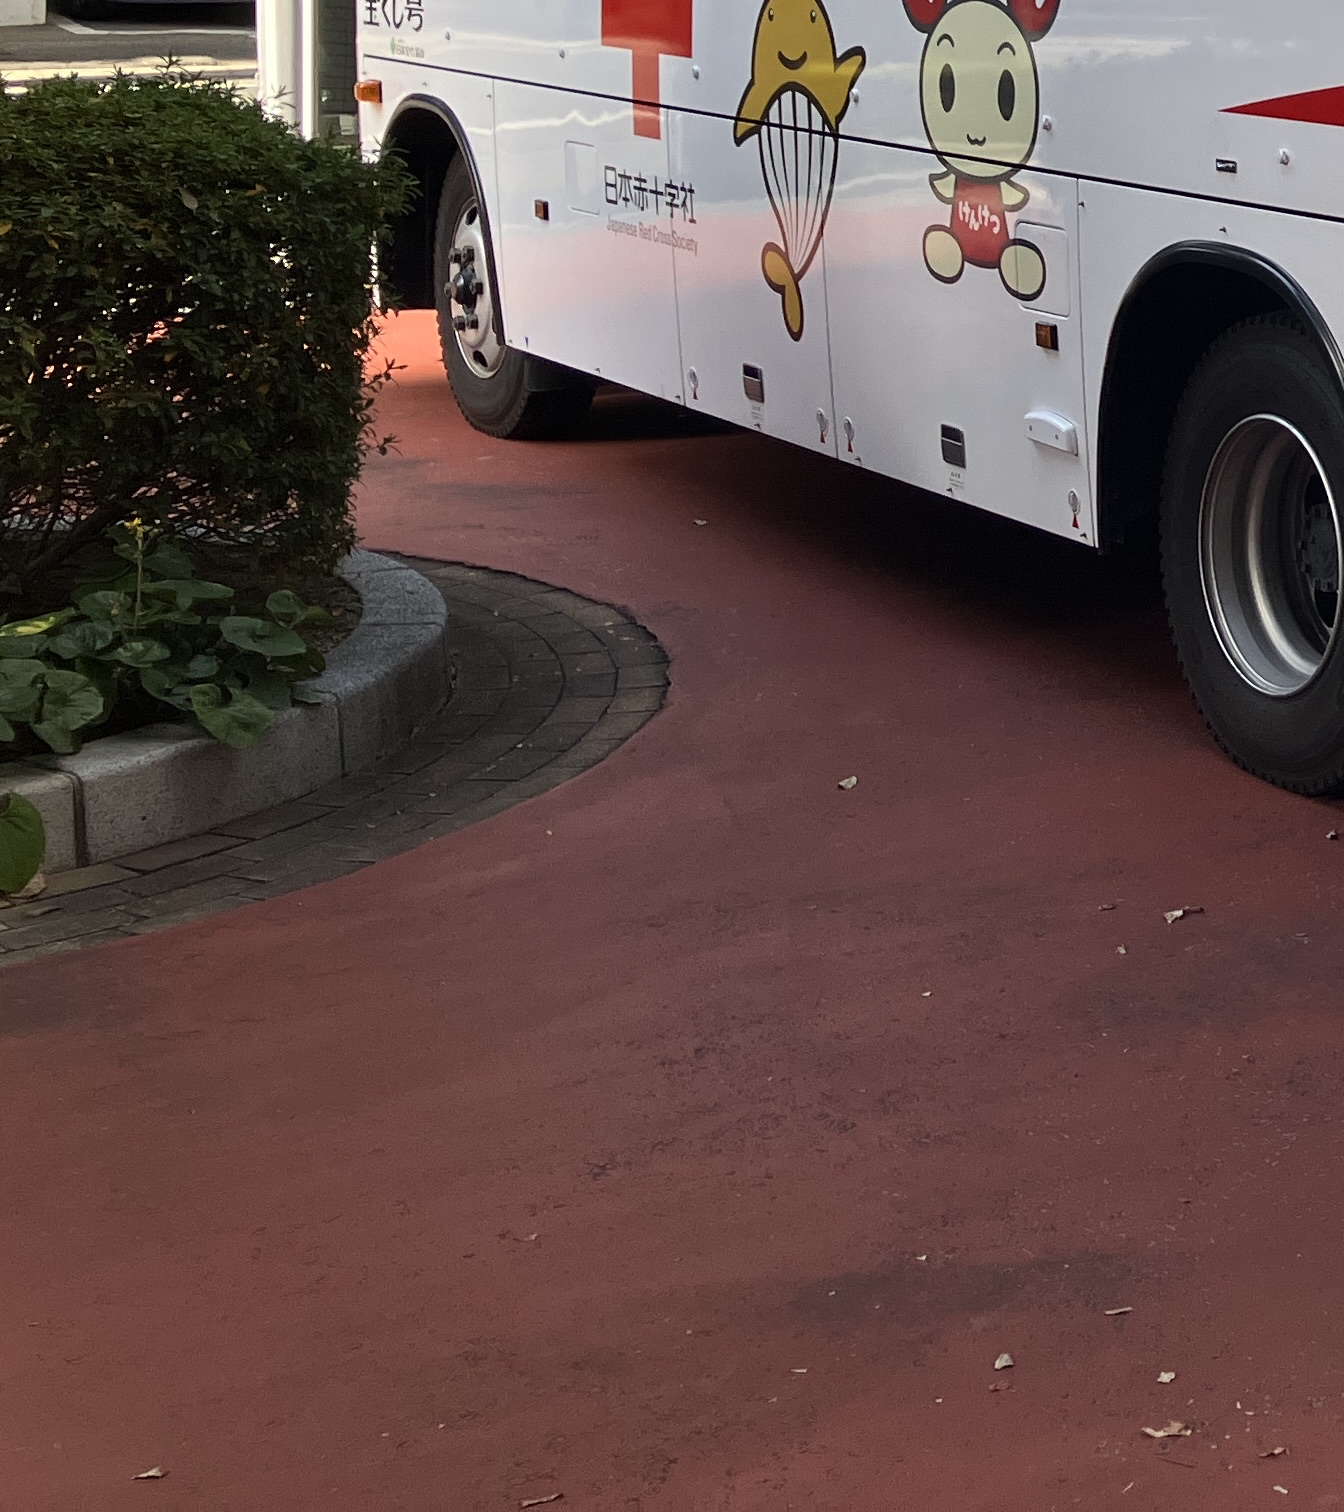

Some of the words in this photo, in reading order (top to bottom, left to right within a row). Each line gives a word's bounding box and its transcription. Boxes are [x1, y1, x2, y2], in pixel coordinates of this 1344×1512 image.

[604, 164, 698, 225] 日本赤十字社
[958, 200, 1001, 235] けんけつ
